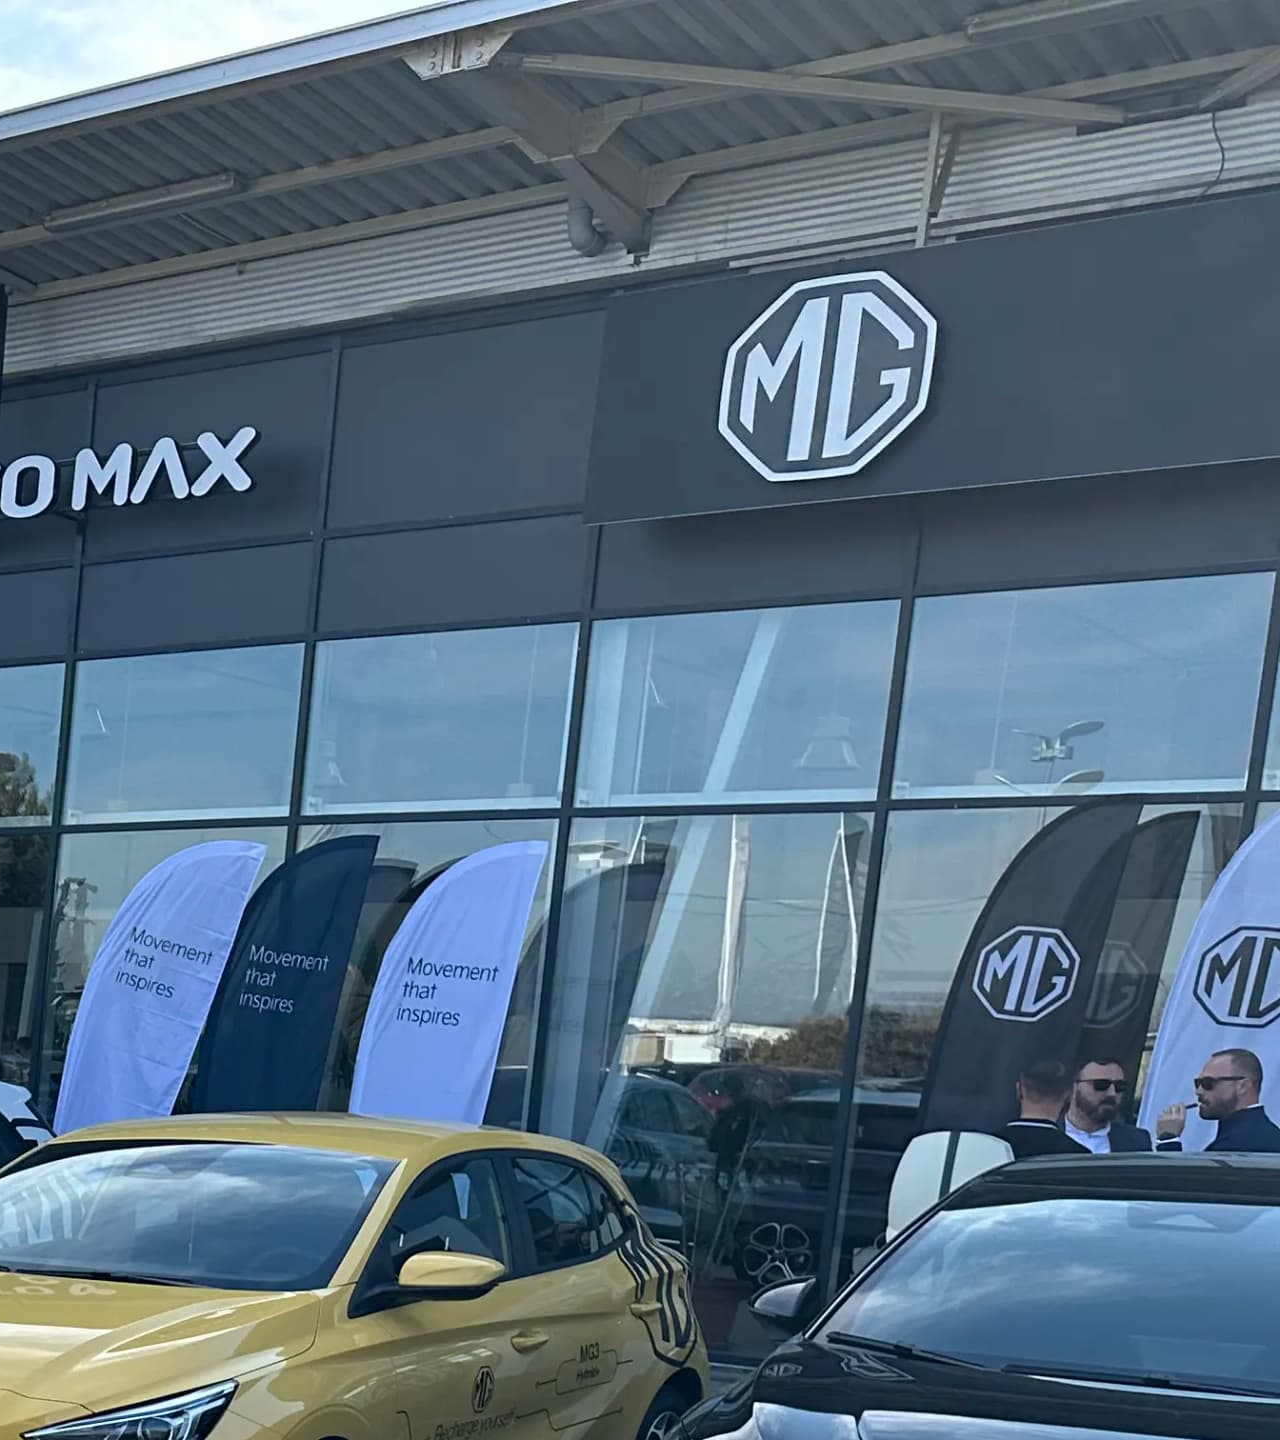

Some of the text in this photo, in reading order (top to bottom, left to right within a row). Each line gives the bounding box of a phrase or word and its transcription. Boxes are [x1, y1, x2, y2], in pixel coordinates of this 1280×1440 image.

[739, 291, 915, 462] MG
[70, 426, 257, 511] MAX
[123, 947, 156, 970] that
[129, 926, 214, 966] Movement
[248, 944, 330, 972] Movement
[115, 967, 176, 999] inspires
[244, 967, 277, 988] that
[406, 956, 500, 983] Movement
[982, 934, 1071, 1014] MG
[239, 990, 295, 1014] inspires
[402, 980, 438, 1000] that
[396, 1002, 461, 1028] inspires
[579, 1342, 600, 1363] MG3
